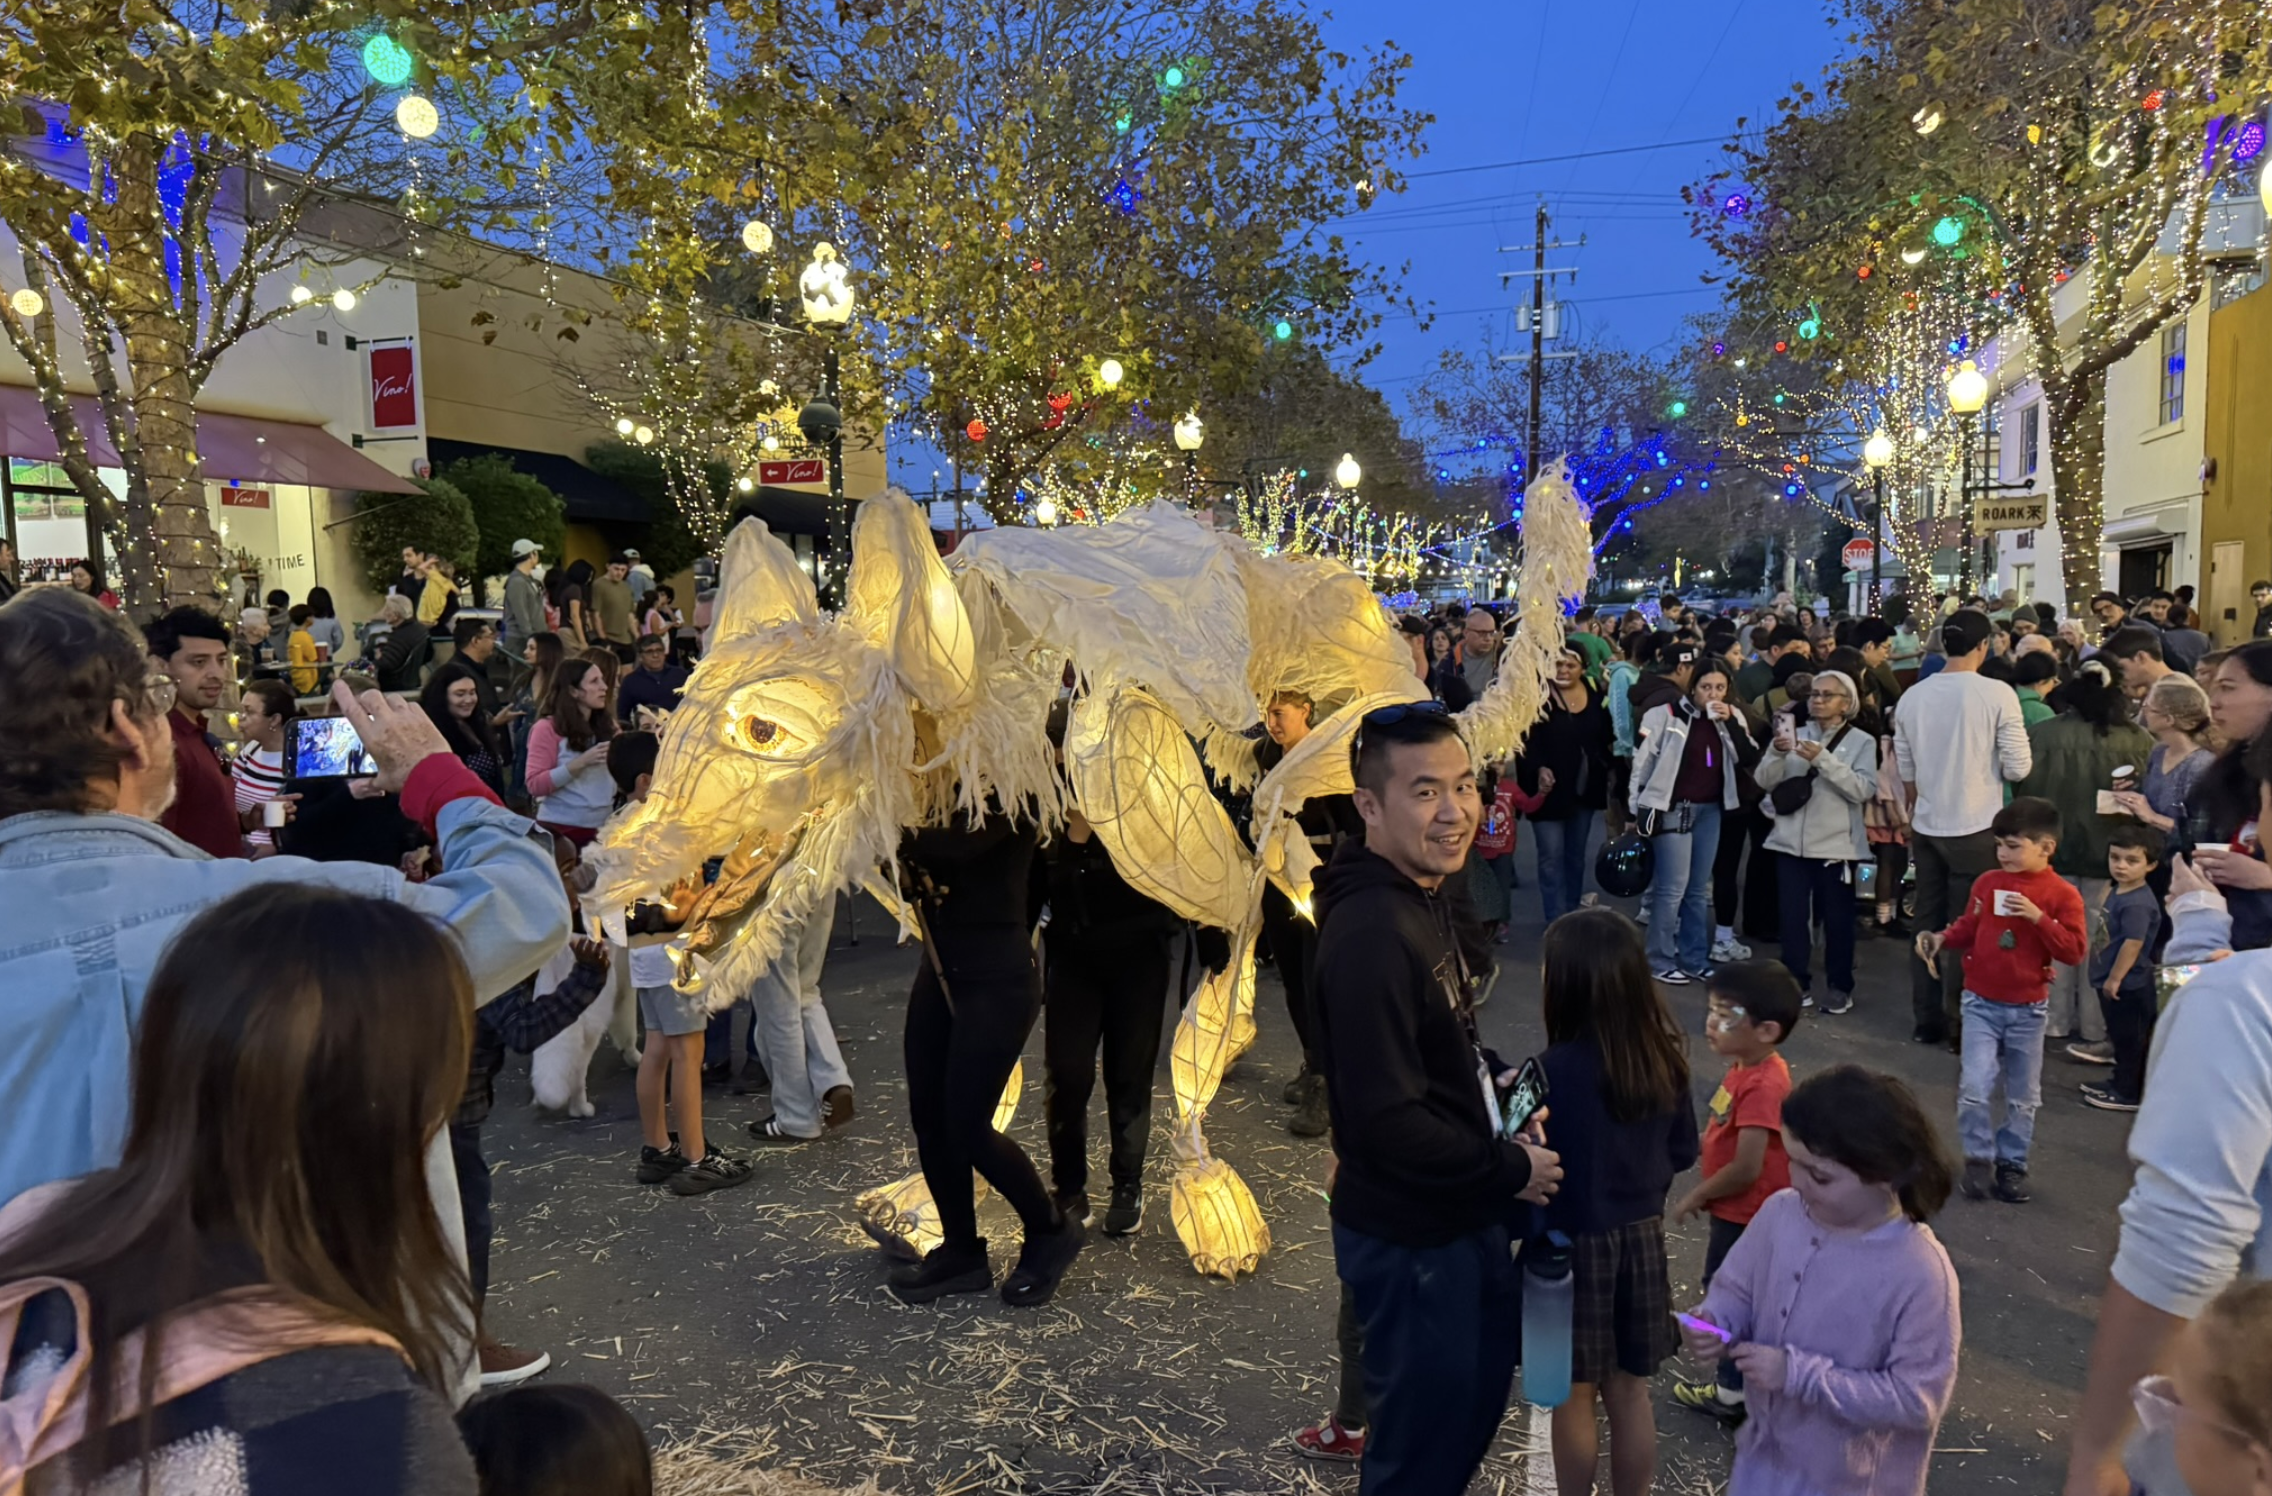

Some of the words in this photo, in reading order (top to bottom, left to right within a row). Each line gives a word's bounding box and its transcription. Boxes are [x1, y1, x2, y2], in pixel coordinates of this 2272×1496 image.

[374, 373, 412, 402] Vino!
[786, 461, 820, 482] Vino!
[233, 489, 259, 504] Vino!
[1982, 507, 2025, 520] ROARK
[275, 554, 305, 570] TIME
